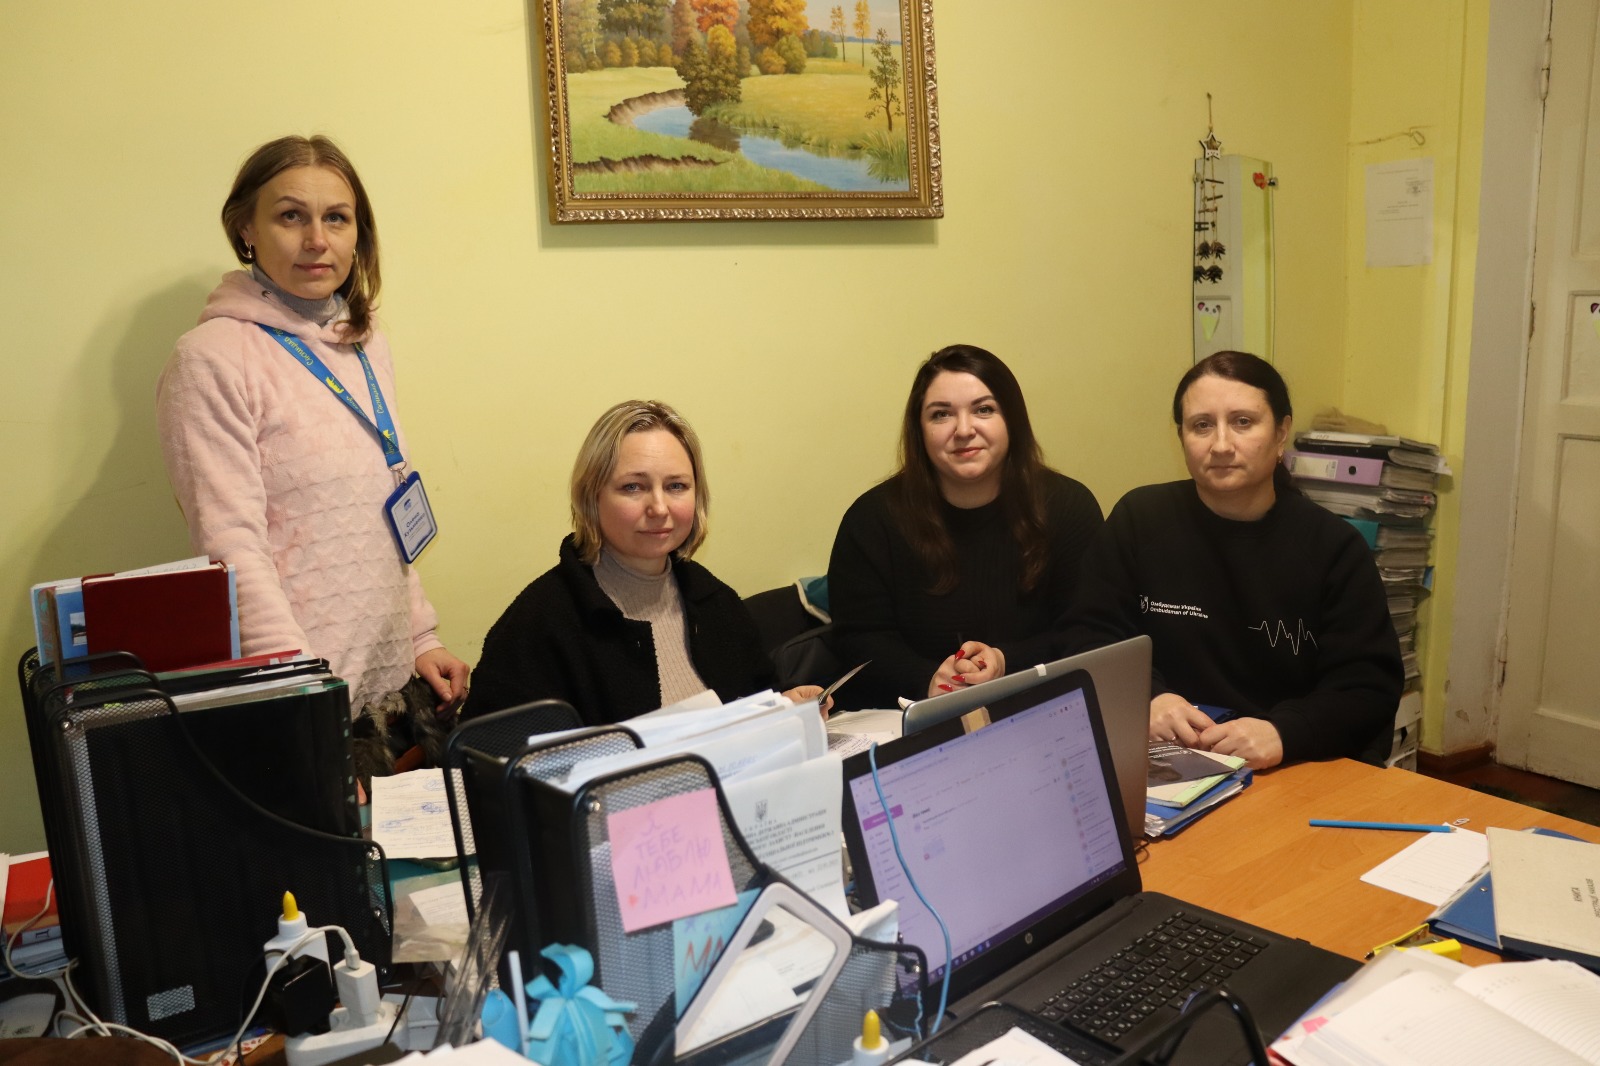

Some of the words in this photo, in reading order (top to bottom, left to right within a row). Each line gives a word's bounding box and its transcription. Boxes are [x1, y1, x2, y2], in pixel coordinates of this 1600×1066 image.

[1150, 606, 1182, 615] Ombudsman
[1189, 610, 1209, 619] Ukraine
[635, 825, 685, 861] ТЕБЕ
